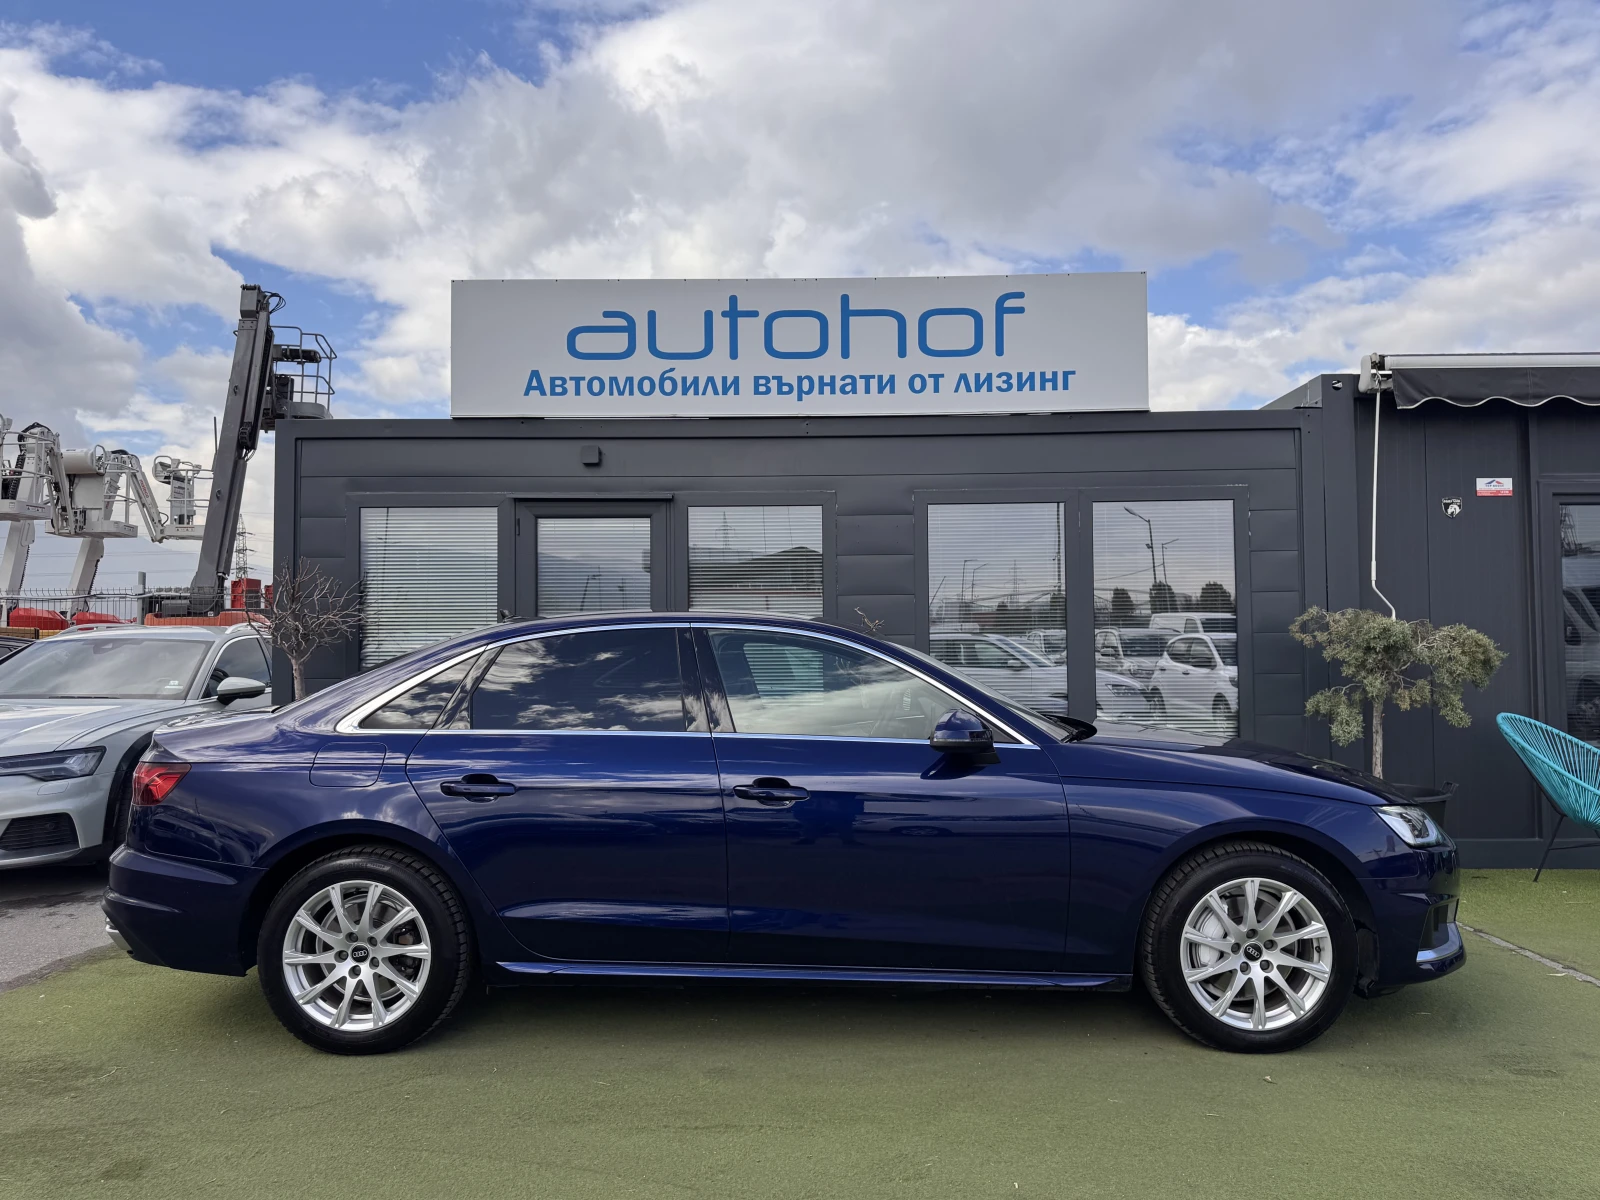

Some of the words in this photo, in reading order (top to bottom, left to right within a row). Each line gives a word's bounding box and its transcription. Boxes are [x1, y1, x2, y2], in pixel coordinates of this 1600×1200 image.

[566, 291, 1026, 361] autohof
[523, 367, 741, 397] Автомобили
[753, 374, 896, 402] върнати
[907, 373, 945, 395] от
[953, 370, 1077, 394] лизинг
